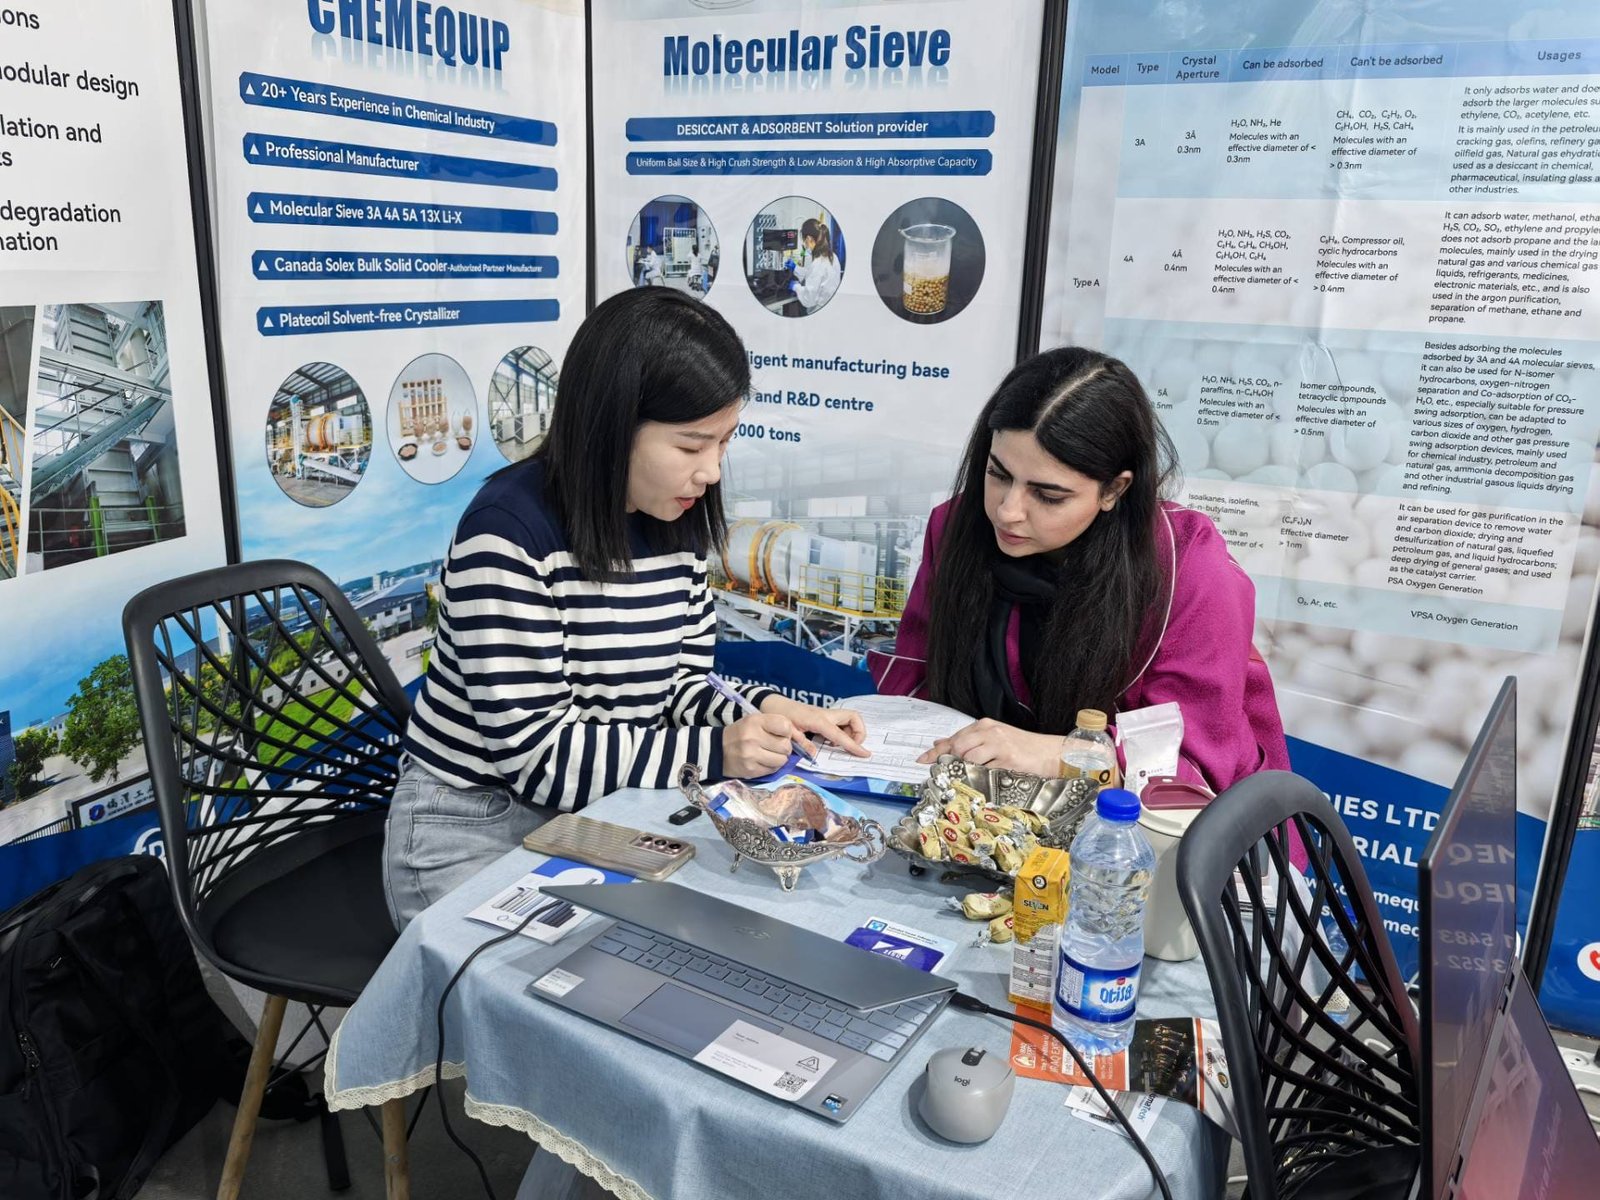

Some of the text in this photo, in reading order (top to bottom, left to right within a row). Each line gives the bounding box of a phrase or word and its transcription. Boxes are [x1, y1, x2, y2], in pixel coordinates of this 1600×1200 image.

[0, 10, 40, 29] ons
[308, 0, 510, 71] CHEMEQUIP
[664, 26, 951, 77] Molecular Sieve
[1538, 51, 1581, 62] Usages
[1182, 55, 1216, 68] Crystal
[1243, 58, 1324, 70] Can be adsorbed
[1351, 55, 1443, 66] Can't be adsorbed
[1091, 65, 1120, 75] Model
[1137, 63, 1159, 74] Type
[0, 62, 139, 100] odular design
[1176, 70, 1220, 81] Aperture
[261, 82, 495, 134] 20+ Years Experience in Chemical Industry
[66, 123, 102, 143] and
[677, 120, 929, 136] DESICCANT & ADSORBENT Solution provider
[1229, 133, 1268, 141] Molecules
[1177, 145, 1201, 154] 0.3nm
[1228, 144, 1261, 152] effective
[1263, 144, 1299, 152] diameter
[266, 142, 419, 171] Professional Manufacturer
[636, 156, 977, 170] Uniform Ball Size & High Crush Strength & Low Abrasion & High Absorptive Capacity
[1227, 155, 1250, 163] 0.3nm
[1453, 161, 1474, 169] used
[1496, 161, 1538, 170] desiccant
[1551, 162, 1593, 171] chemical,
[1449, 185, 1519, 194] other industries.
[0, 200, 121, 226] degradation
[270, 200, 462, 224] Molecular Sieve 3A 4A 5A 13X Li-X
[1342, 236, 1405, 246] Compressor oil,
[1318, 247, 1398, 257] cyclic hydrocarbons
[275, 257, 323, 272] Canada
[326, 258, 355, 272] Solex
[358, 258, 383, 272] Bulk
[385, 258, 412, 272] Solid
[1164, 264, 1187, 272] 0.4nm
[1073, 278, 1100, 288] Type A
[280, 307, 460, 327] Platecoil Solvent-free Crystallizer
[1425, 341, 1562, 356] Besides adsorbing the molecules
[792, 356, 907, 380] manufacturing
[912, 361, 950, 378] base
[1300, 381, 1376, 394] Isomer compounds,
[755, 390, 782, 404] and
[787, 391, 820, 407] R&D
[825, 397, 874, 412] centre
[1299, 393, 1386, 405] tetracyclic compounds
[769, 427, 801, 442] tons
[1399, 503, 1405, 511] It
[1424, 505, 1434, 513] be
[1458, 508, 1470, 516] for
[1489, 513, 1537, 523] purification
[1549, 517, 1564, 526] the
[1281, 528, 1349, 541] Effective diameter
[1388, 577, 1483, 594] PSA Oxygen Generation
[1411, 610, 1518, 630] VPSA Oxygen Generation
[1386, 804, 1439, 832] LTD
[954, 1075, 971, 1087] logi
